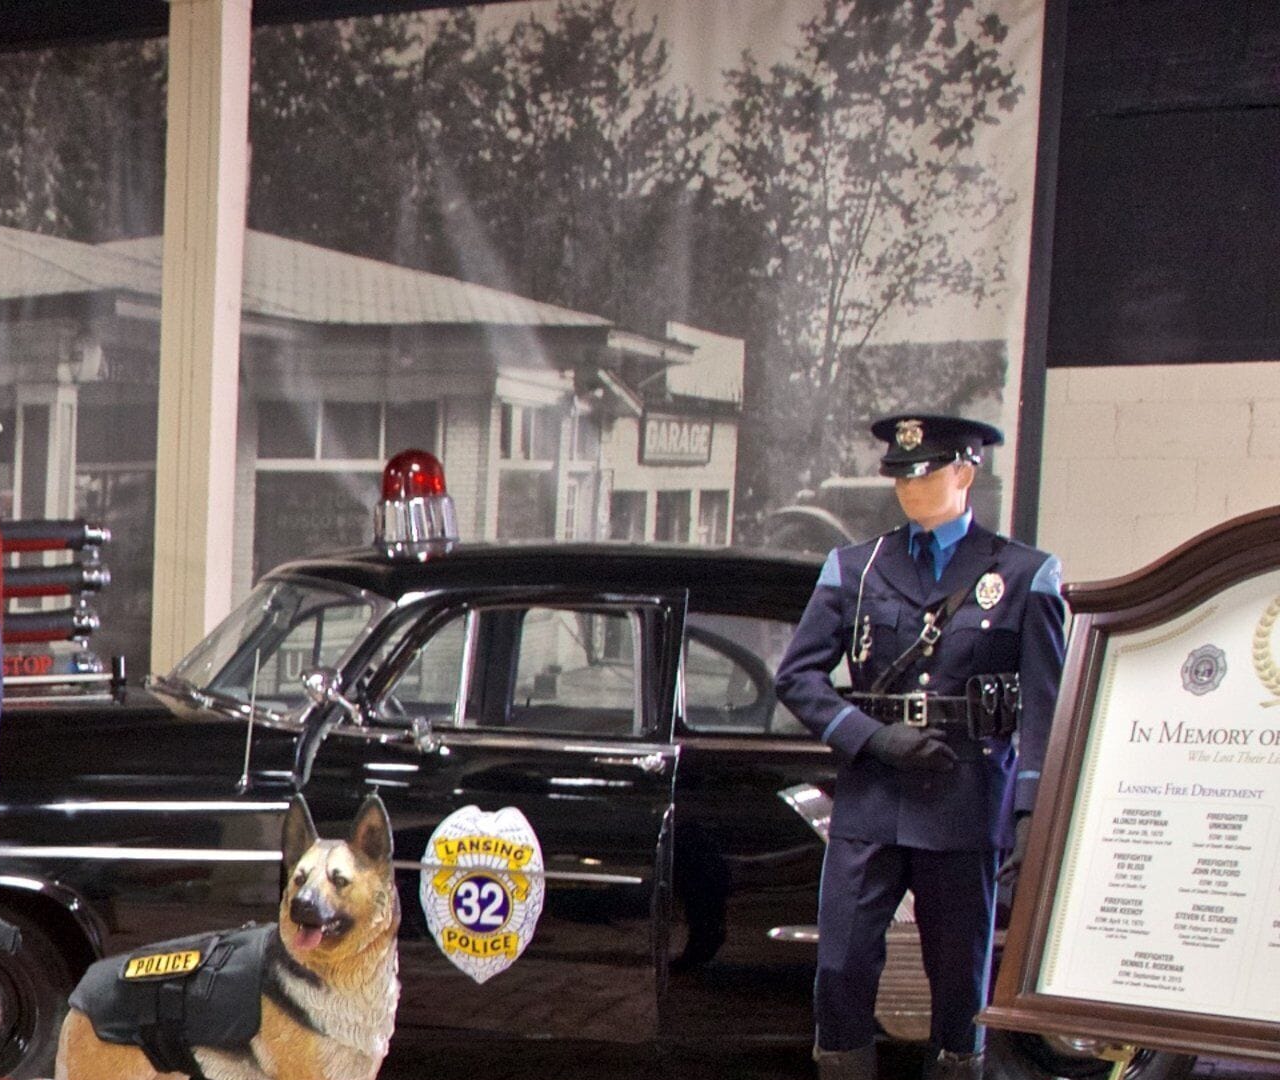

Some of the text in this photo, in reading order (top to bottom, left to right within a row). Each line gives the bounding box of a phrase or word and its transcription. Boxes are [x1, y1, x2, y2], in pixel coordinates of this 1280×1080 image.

[645, 420, 710, 454] GARAGE
[1158, 720, 1254, 746] MEMORY
[443, 840, 525, 861] LANSING
[456, 881, 504, 925] 32
[447, 930, 512, 954] POLICE
[135, 953, 193, 975] POLICE
